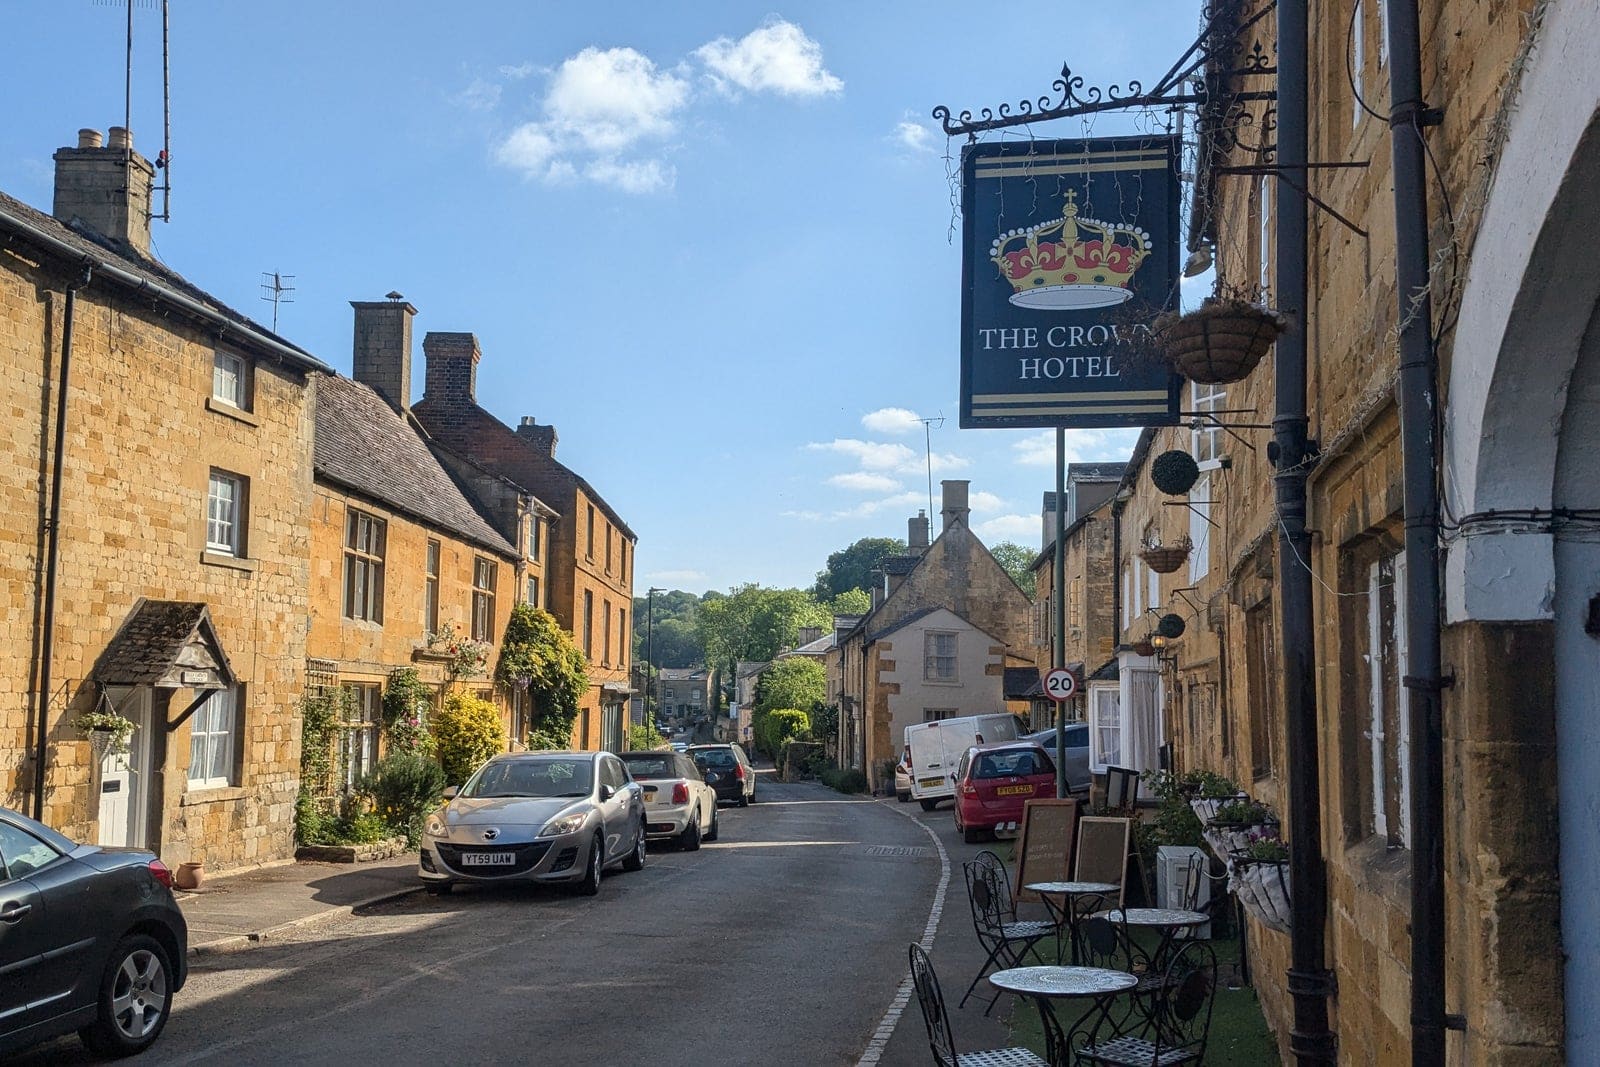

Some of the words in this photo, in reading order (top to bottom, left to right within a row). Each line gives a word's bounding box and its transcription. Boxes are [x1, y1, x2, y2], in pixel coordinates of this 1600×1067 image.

[979, 326, 1039, 350] THE
[1019, 355, 1121, 380] HOTEL
[1049, 677, 1072, 691] 20
[466, 854, 490, 864] YT59
[492, 854, 511, 864] UAW
